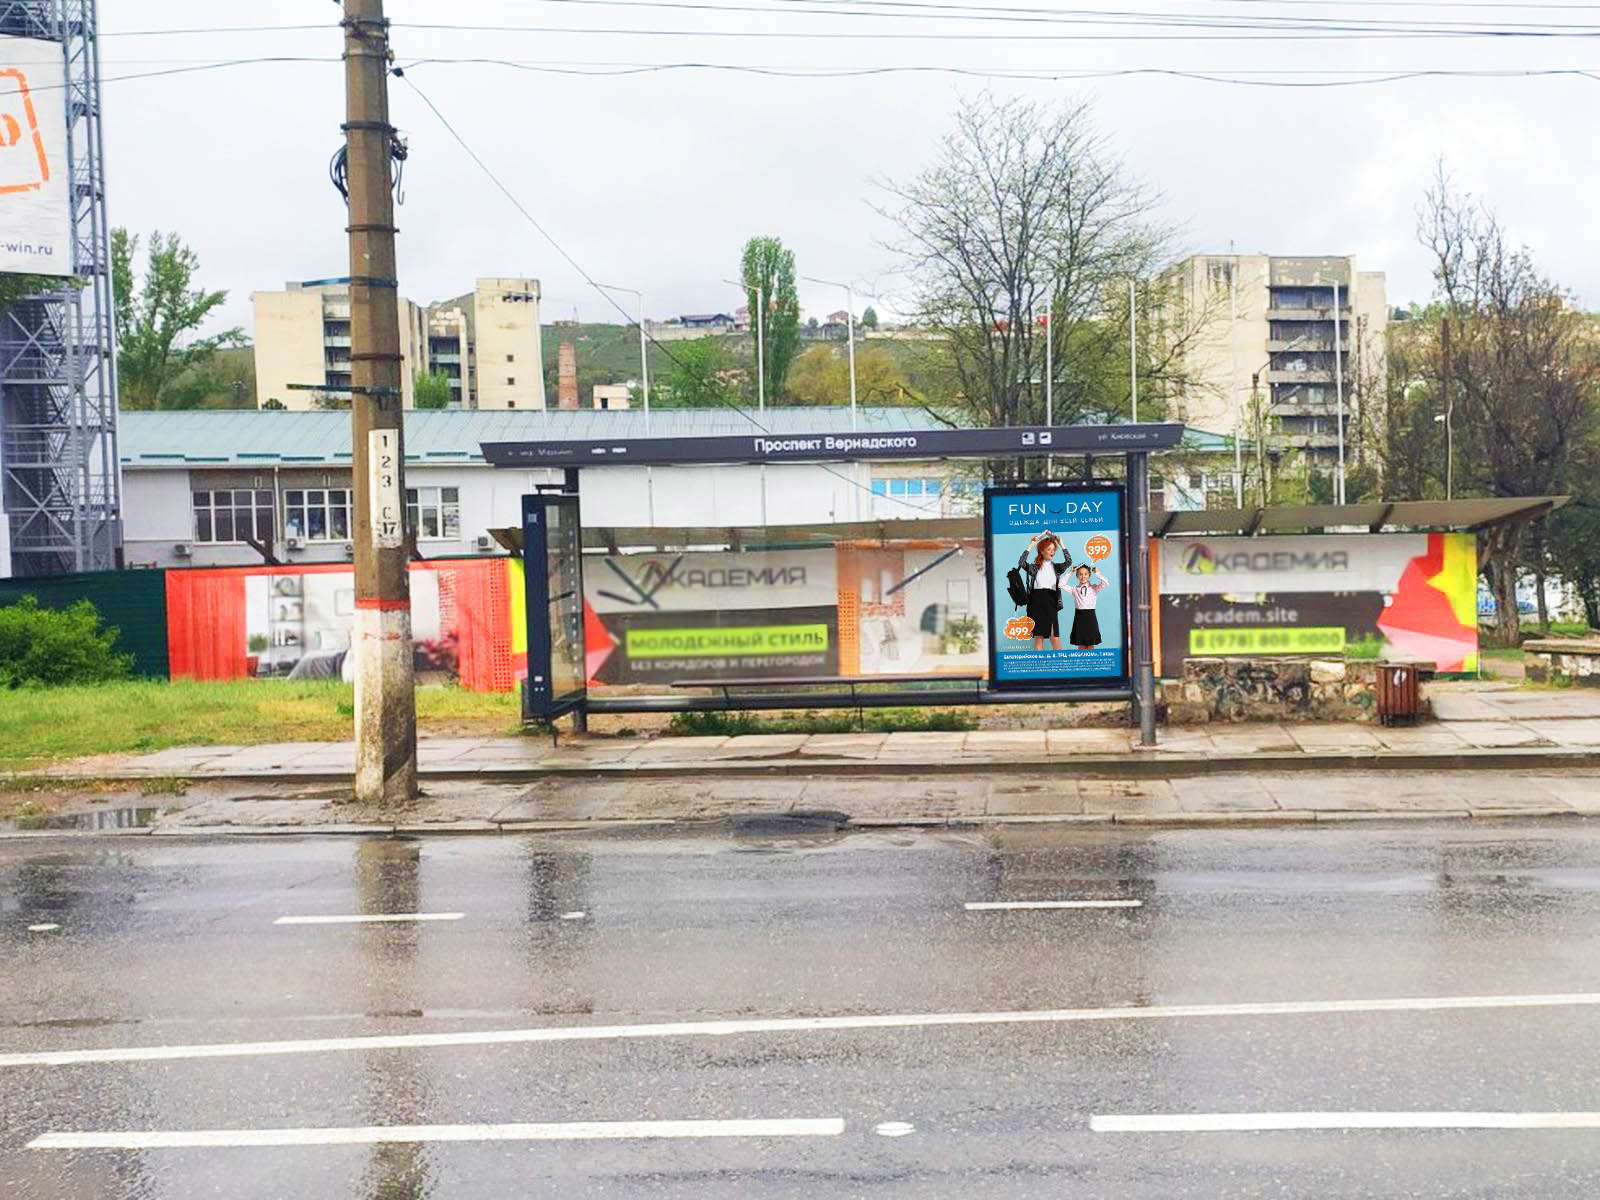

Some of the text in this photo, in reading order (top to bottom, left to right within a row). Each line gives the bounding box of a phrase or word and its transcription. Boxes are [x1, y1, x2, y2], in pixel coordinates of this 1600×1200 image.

[754, 436, 917, 453] Проспект Вернадского
[382, 455, 391, 468] 2
[1008, 501, 1103, 515] FUN DAY
[1194, 606, 1298, 624] academ.site
[768, 632, 824, 647] СТИЛЬ
